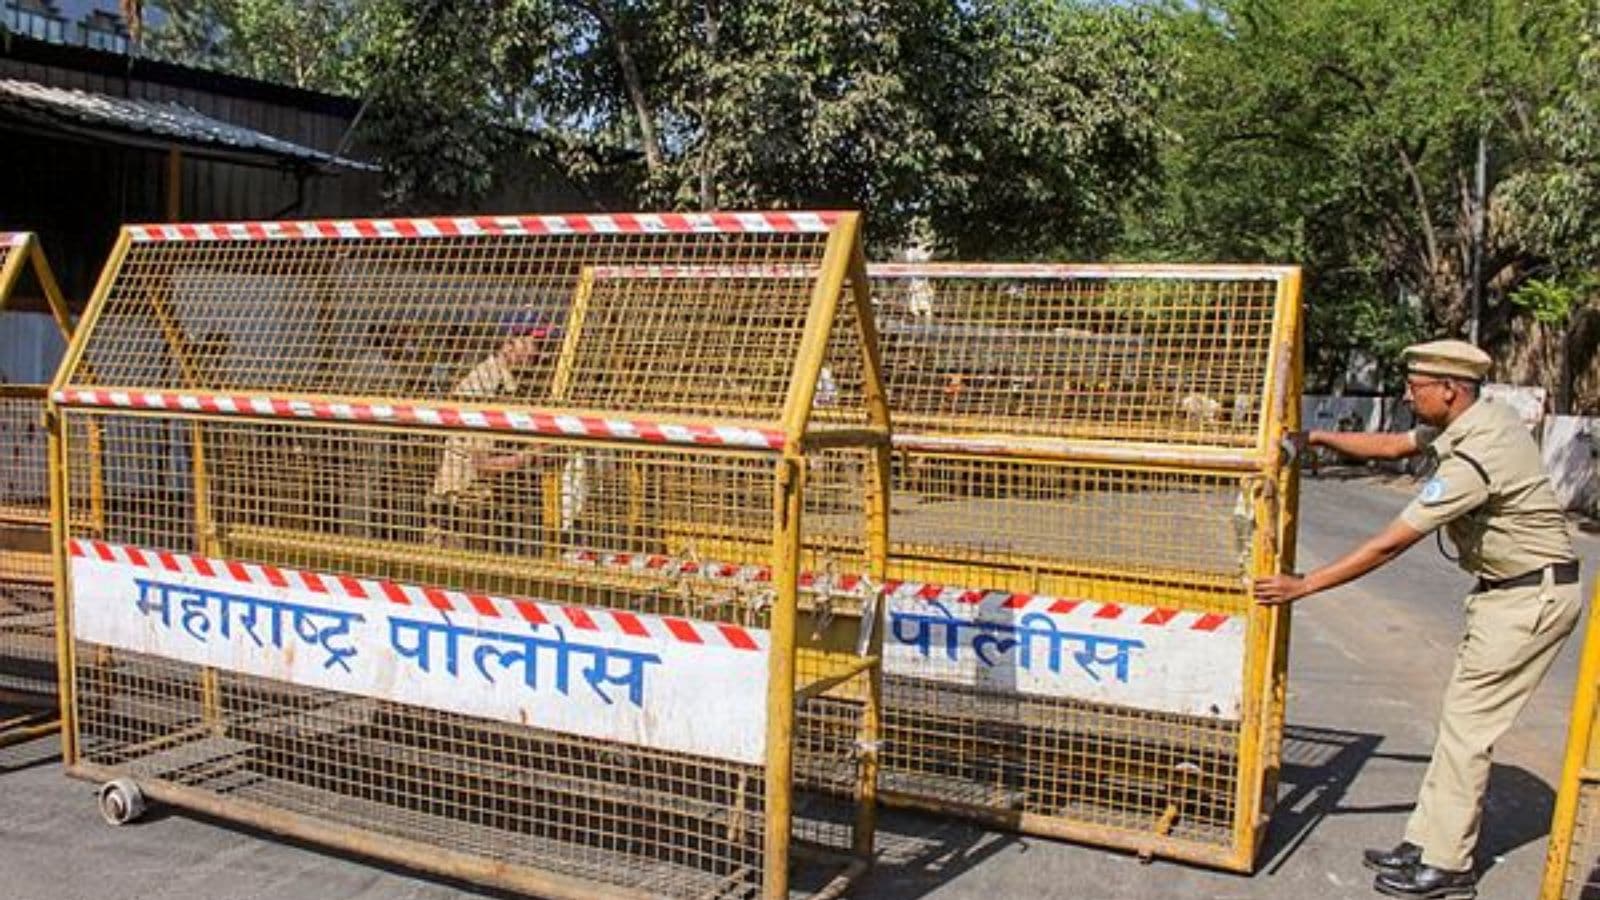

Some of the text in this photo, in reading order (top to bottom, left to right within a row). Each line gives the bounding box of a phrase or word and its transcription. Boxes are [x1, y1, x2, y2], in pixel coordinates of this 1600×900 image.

[134, 578, 662, 708] महाराष्ट्र पोलीस
[890, 600, 1146, 683] पोलीस
